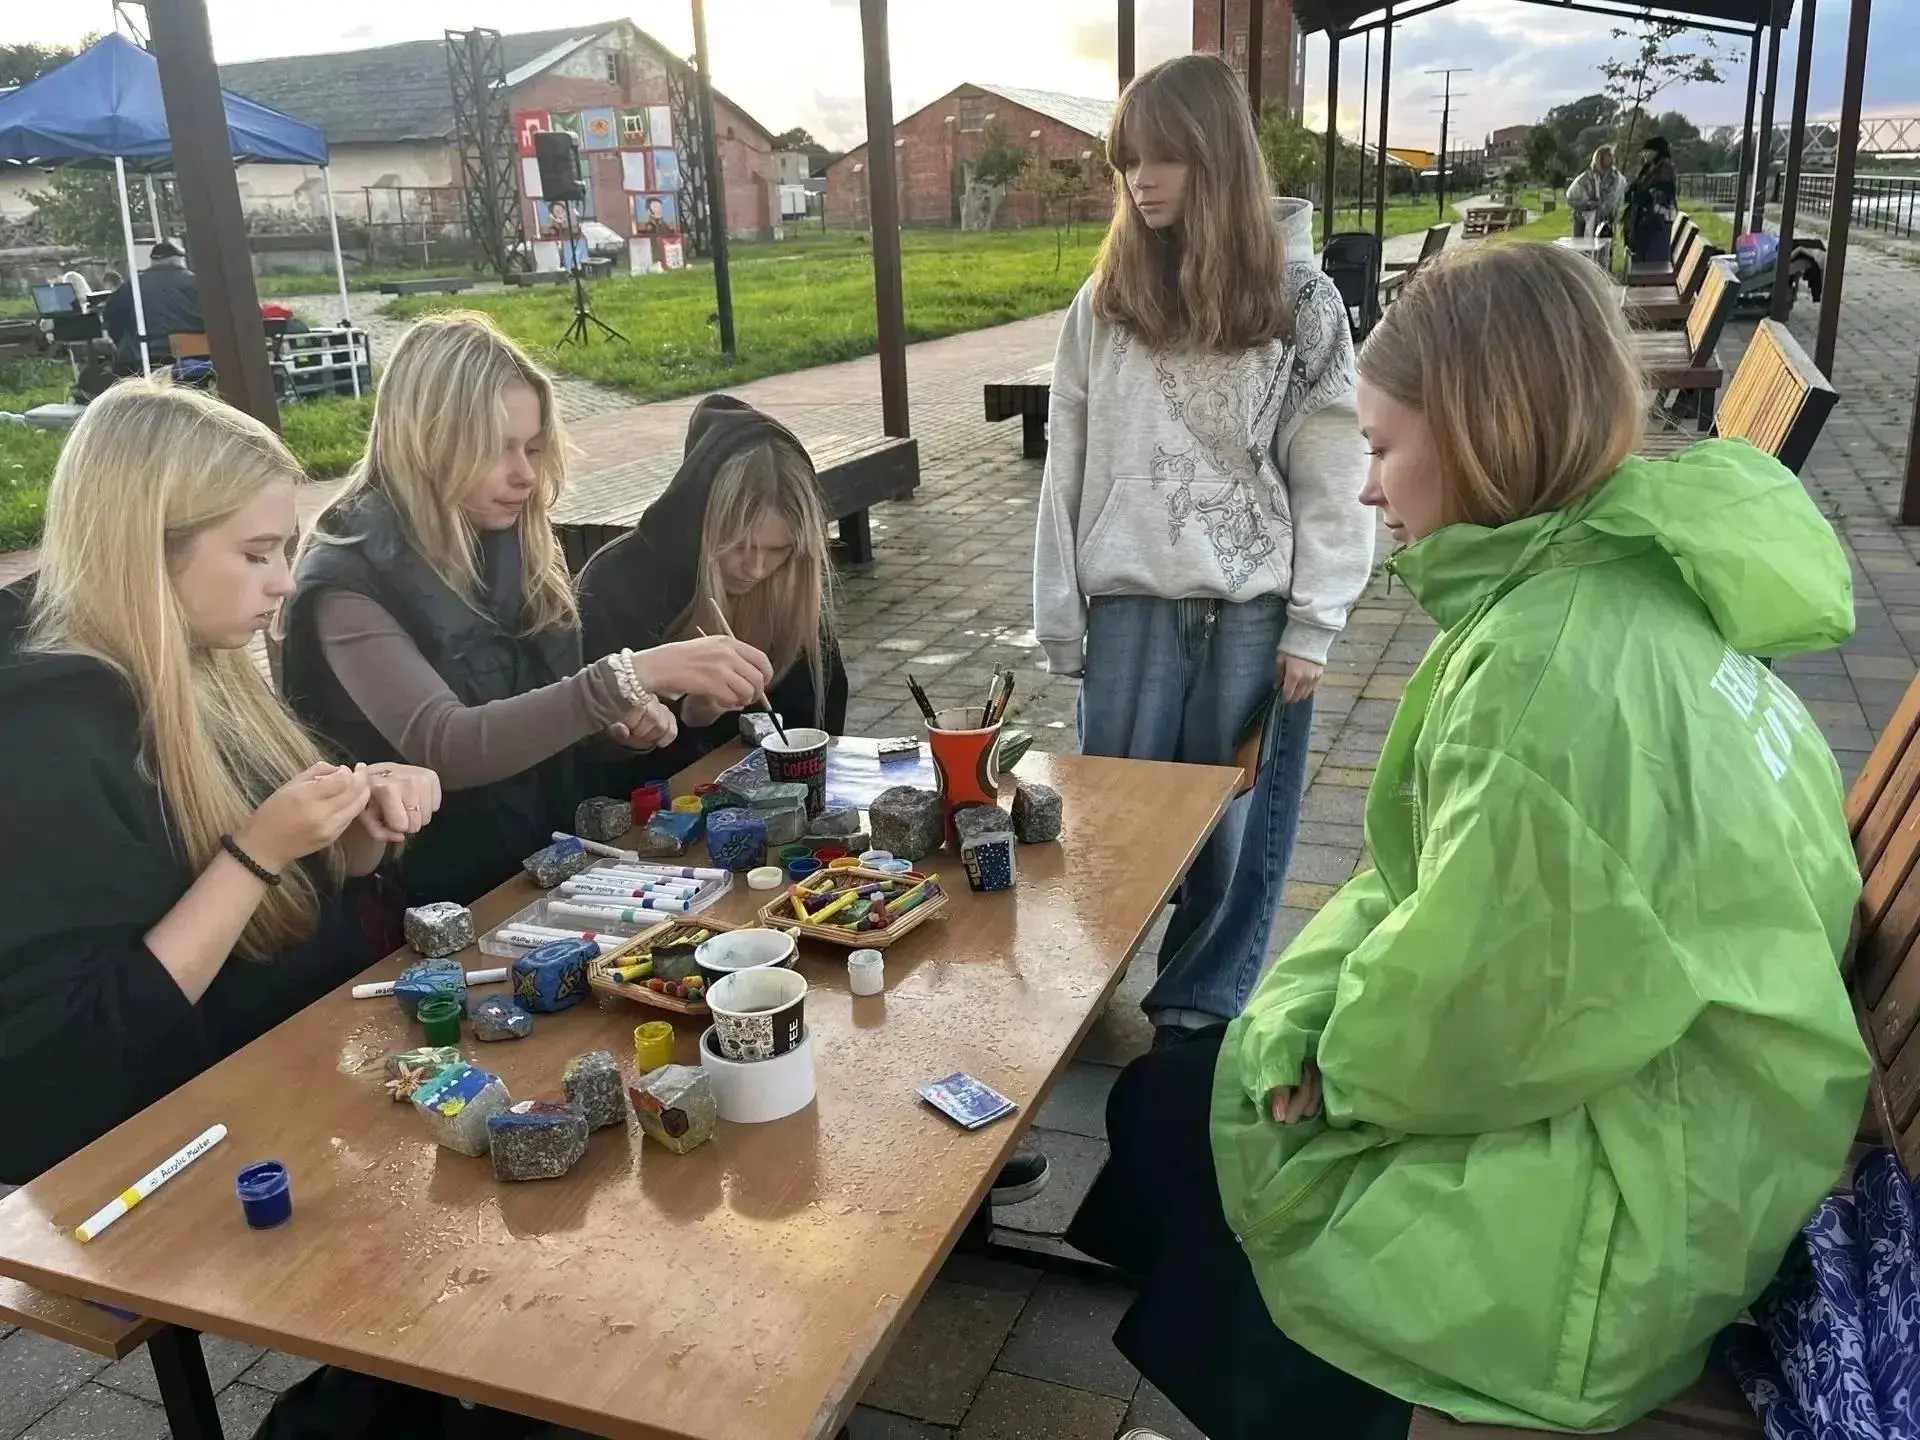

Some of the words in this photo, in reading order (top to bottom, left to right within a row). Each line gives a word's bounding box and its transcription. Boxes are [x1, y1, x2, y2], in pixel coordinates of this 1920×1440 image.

[789, 1018, 799, 1050] FEE
[160, 1156, 188, 1178] Acrylic
[186, 1138, 210, 1159] Marker
